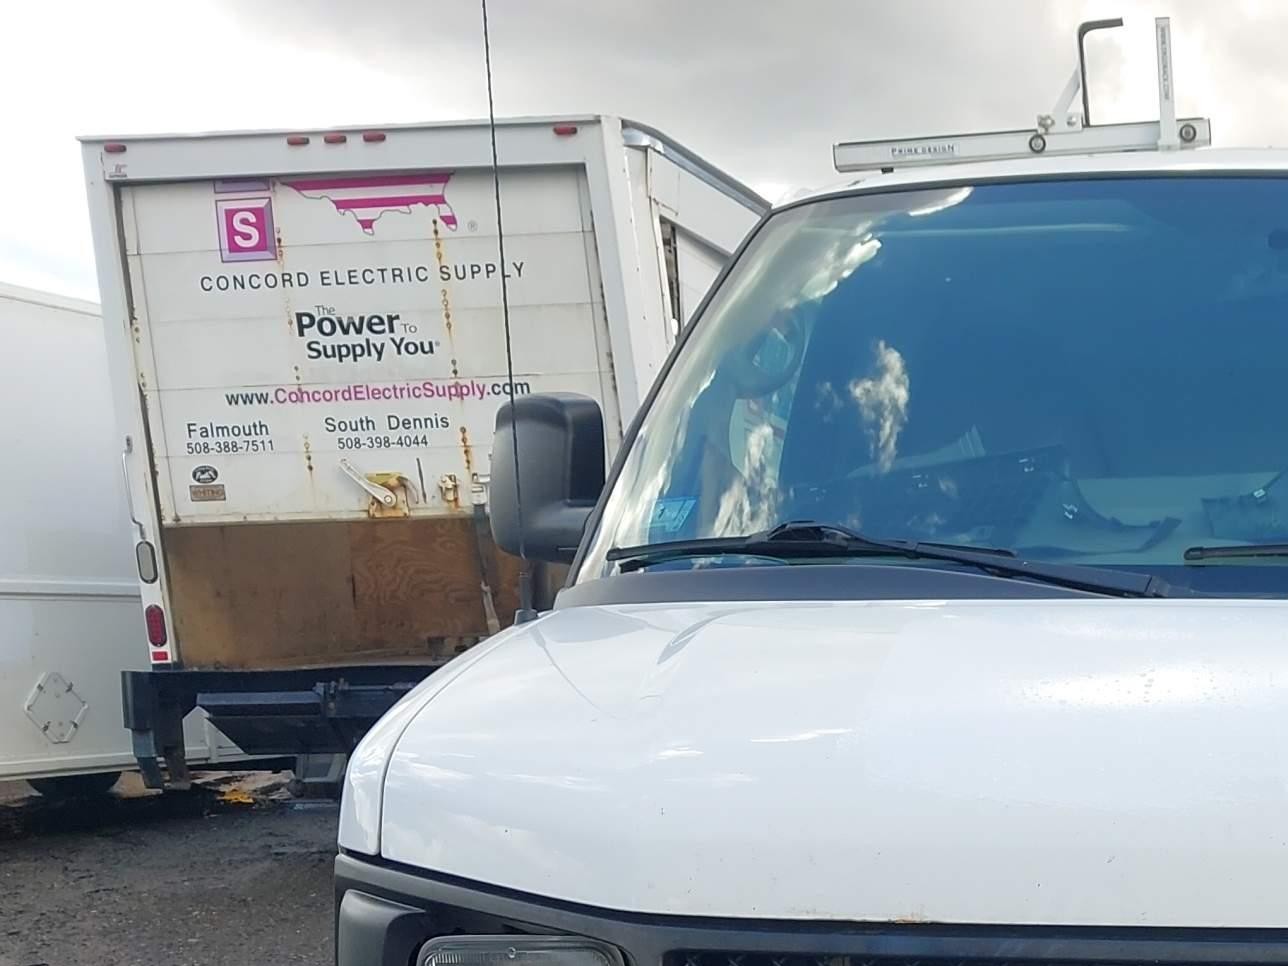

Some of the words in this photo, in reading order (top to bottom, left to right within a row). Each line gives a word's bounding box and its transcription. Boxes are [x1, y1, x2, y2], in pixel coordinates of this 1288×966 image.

[232, 211, 260, 248] S
[200, 271, 309, 292] CONCORD
[320, 266, 429, 287] ELECTRIC
[315, 304, 335, 316] The
[295, 311, 400, 337] Power
[401, 323, 417, 334] To
[306, 338, 385, 363] Supply
[389, 336, 435, 356] You
[225, 379, 531, 406] www.ConcordElectricSupply.com
[186, 420, 269, 439] Falmouth
[324, 415, 376, 433] South
[387, 413, 450, 431] Dennis
[186, 439, 275, 455] 508-388-7511
[337, 435, 429, 450] 508-398-4044
